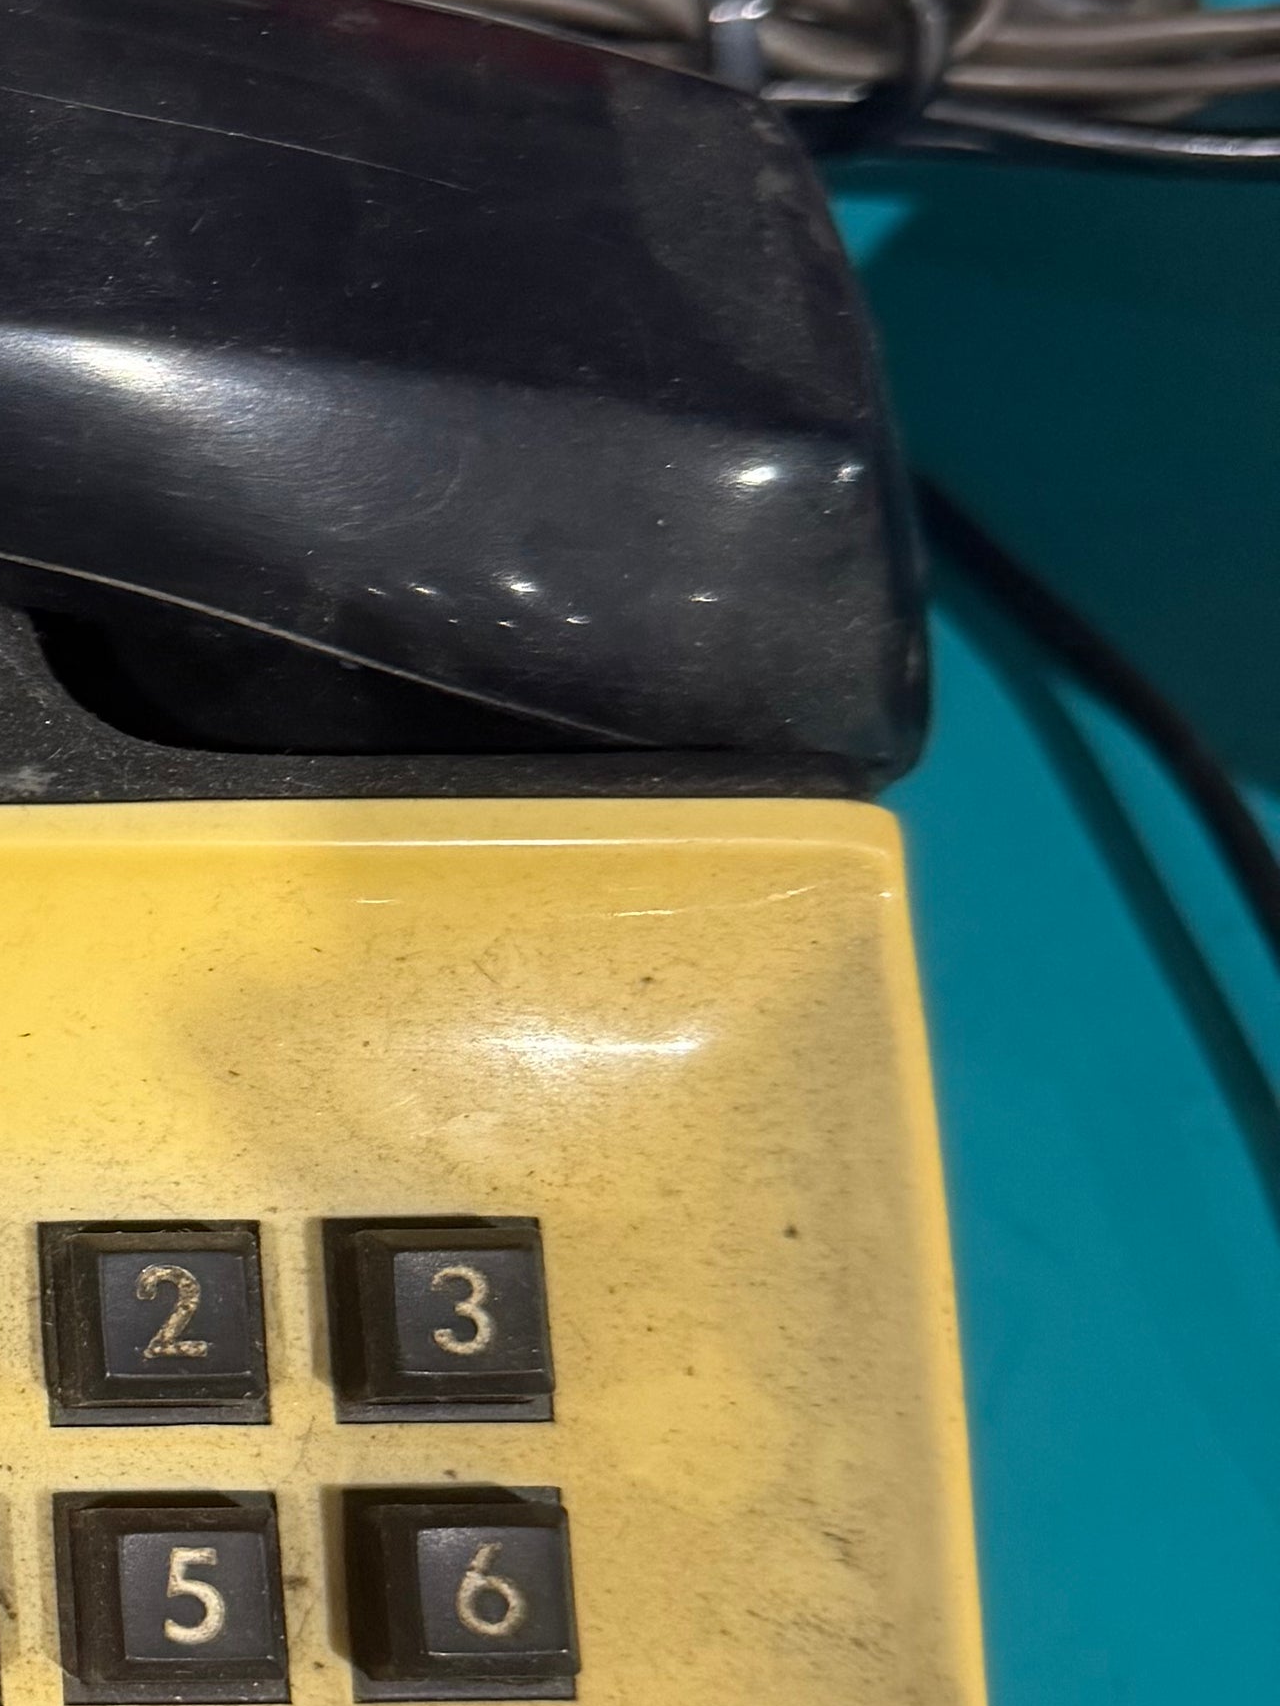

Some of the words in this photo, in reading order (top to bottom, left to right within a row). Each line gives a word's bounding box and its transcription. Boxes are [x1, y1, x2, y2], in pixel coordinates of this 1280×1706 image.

[136, 1263, 208, 1359] 2
[431, 1263, 493, 1355] 3
[163, 1546, 226, 1645] 5
[456, 1542, 523, 1636] 6
